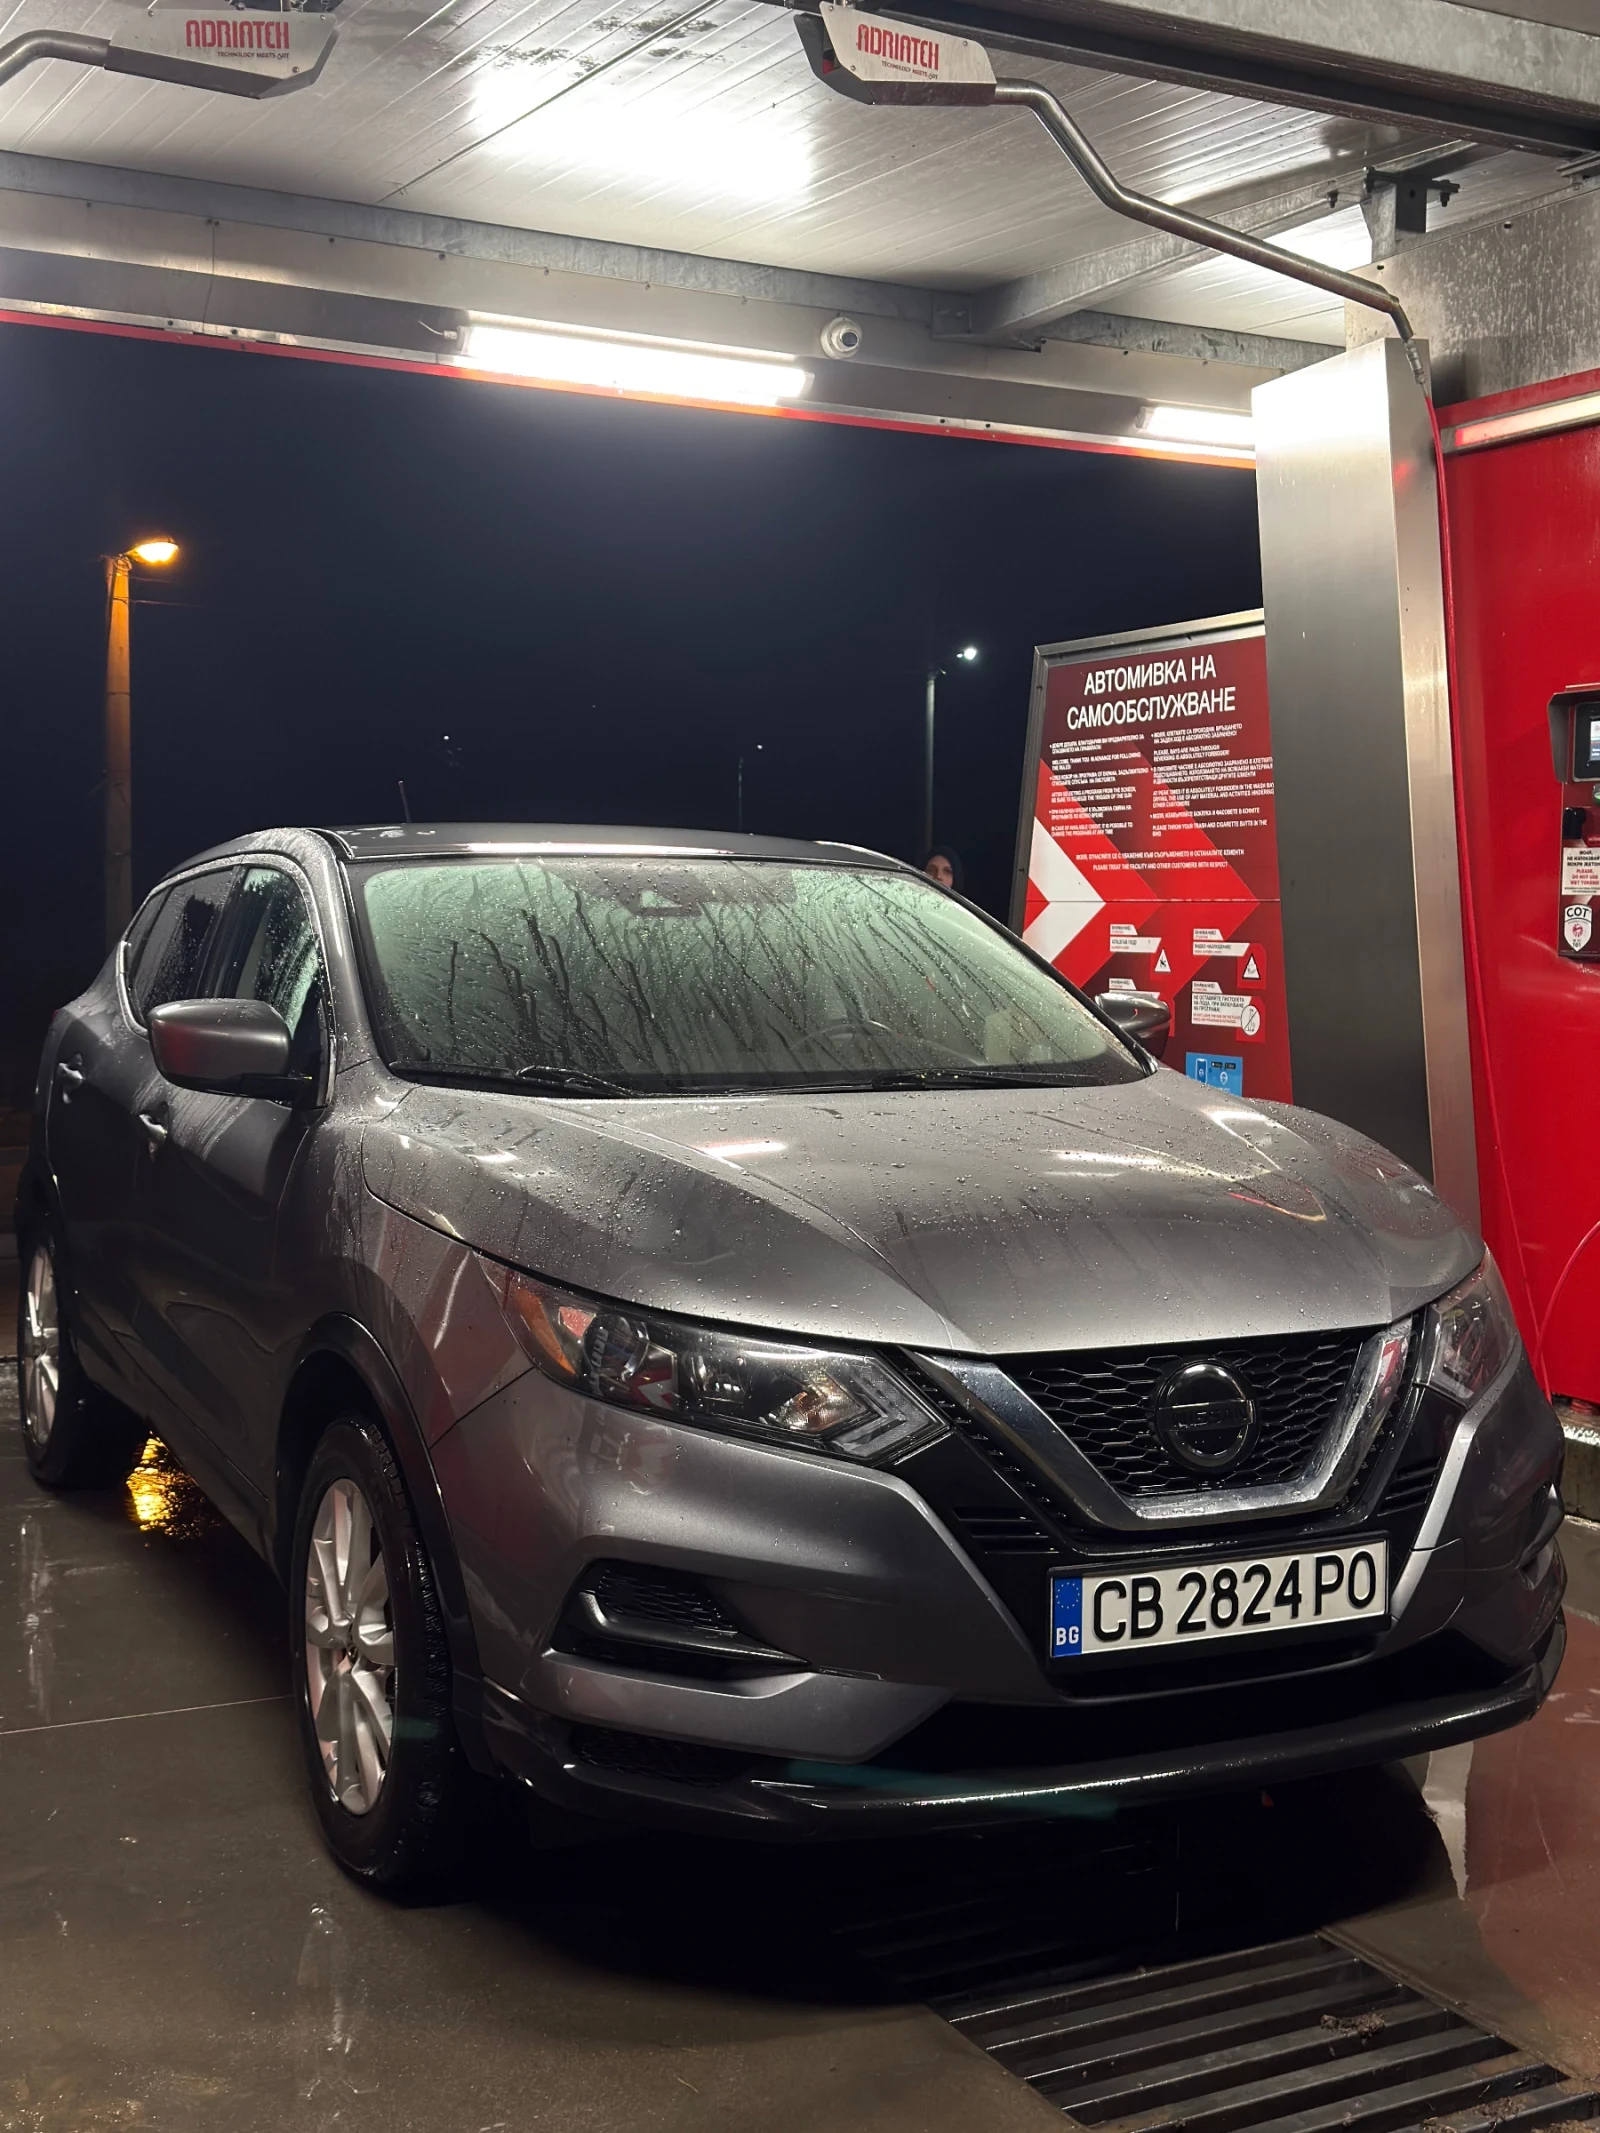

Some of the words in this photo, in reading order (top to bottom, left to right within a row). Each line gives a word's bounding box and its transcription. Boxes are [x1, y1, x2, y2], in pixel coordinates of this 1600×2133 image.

[1084, 659, 1187, 696] АВТОМИВКА
[1191, 654, 1217, 681] НА
[1066, 686, 1237, 730] САМООБСЛУЖВАНЕ
[1093, 1576, 1163, 1642] CB
[1177, 1559, 1302, 1635] 2824
[1314, 1550, 1376, 1616] PO
[1056, 1626, 1079, 1645] BG
